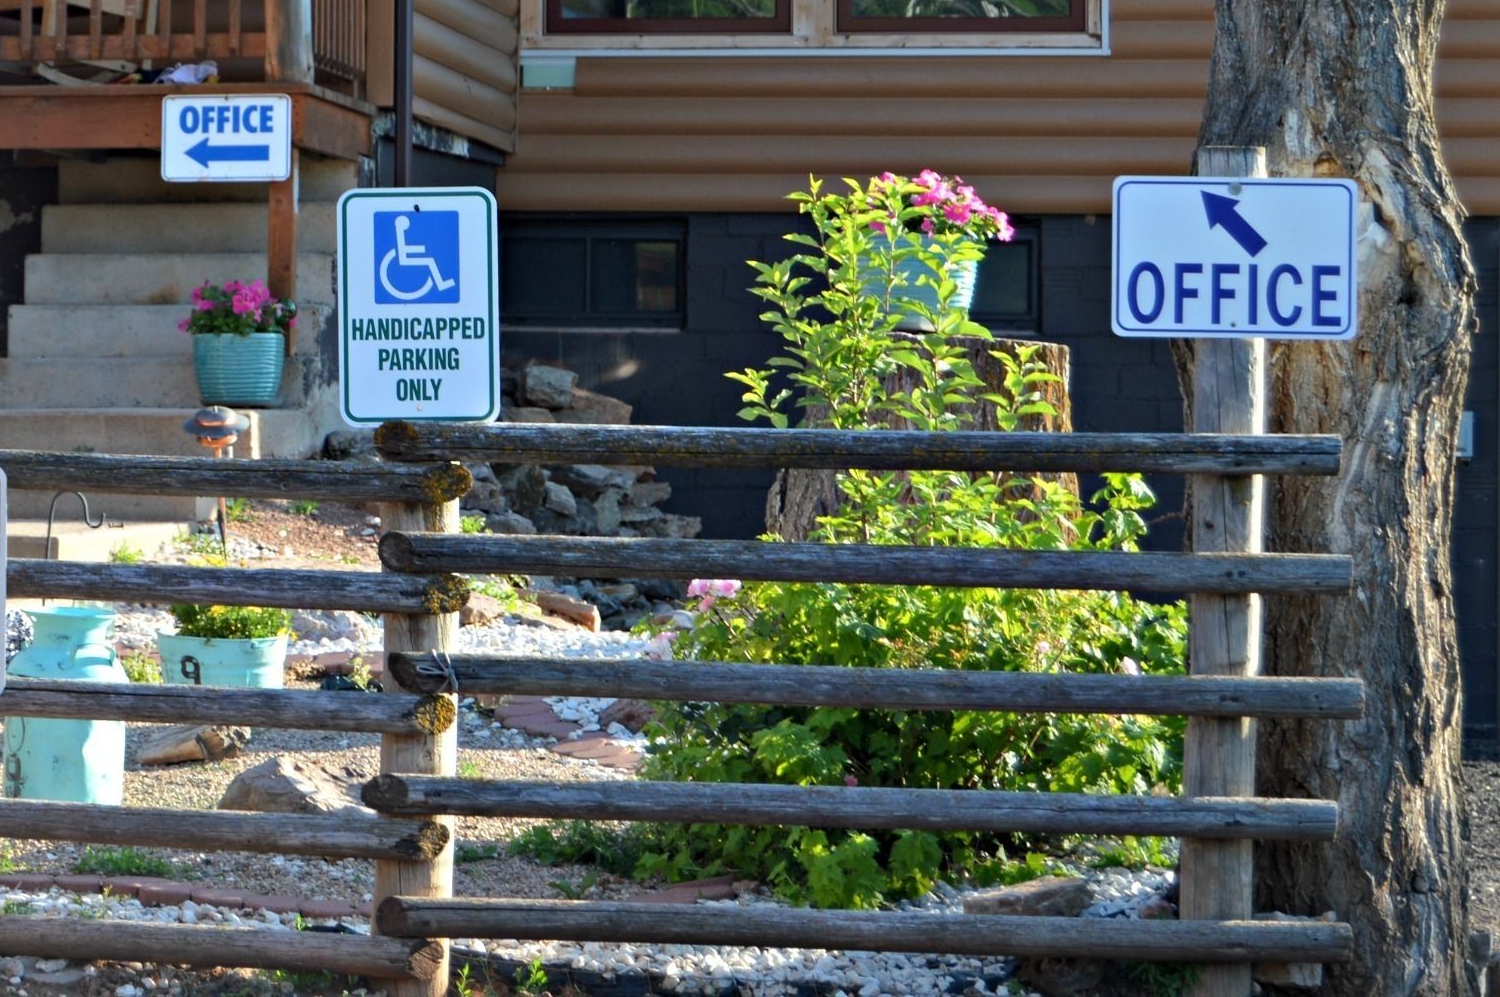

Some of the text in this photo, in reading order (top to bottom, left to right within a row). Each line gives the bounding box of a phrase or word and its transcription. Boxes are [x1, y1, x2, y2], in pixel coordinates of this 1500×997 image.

[179, 104, 274, 134] OFFICE
[1127, 261, 1342, 327] OFFICE
[351, 317, 485, 341] HANDICAPPED
[378, 348, 460, 371] PARKING
[395, 378, 442, 401] ONLY
